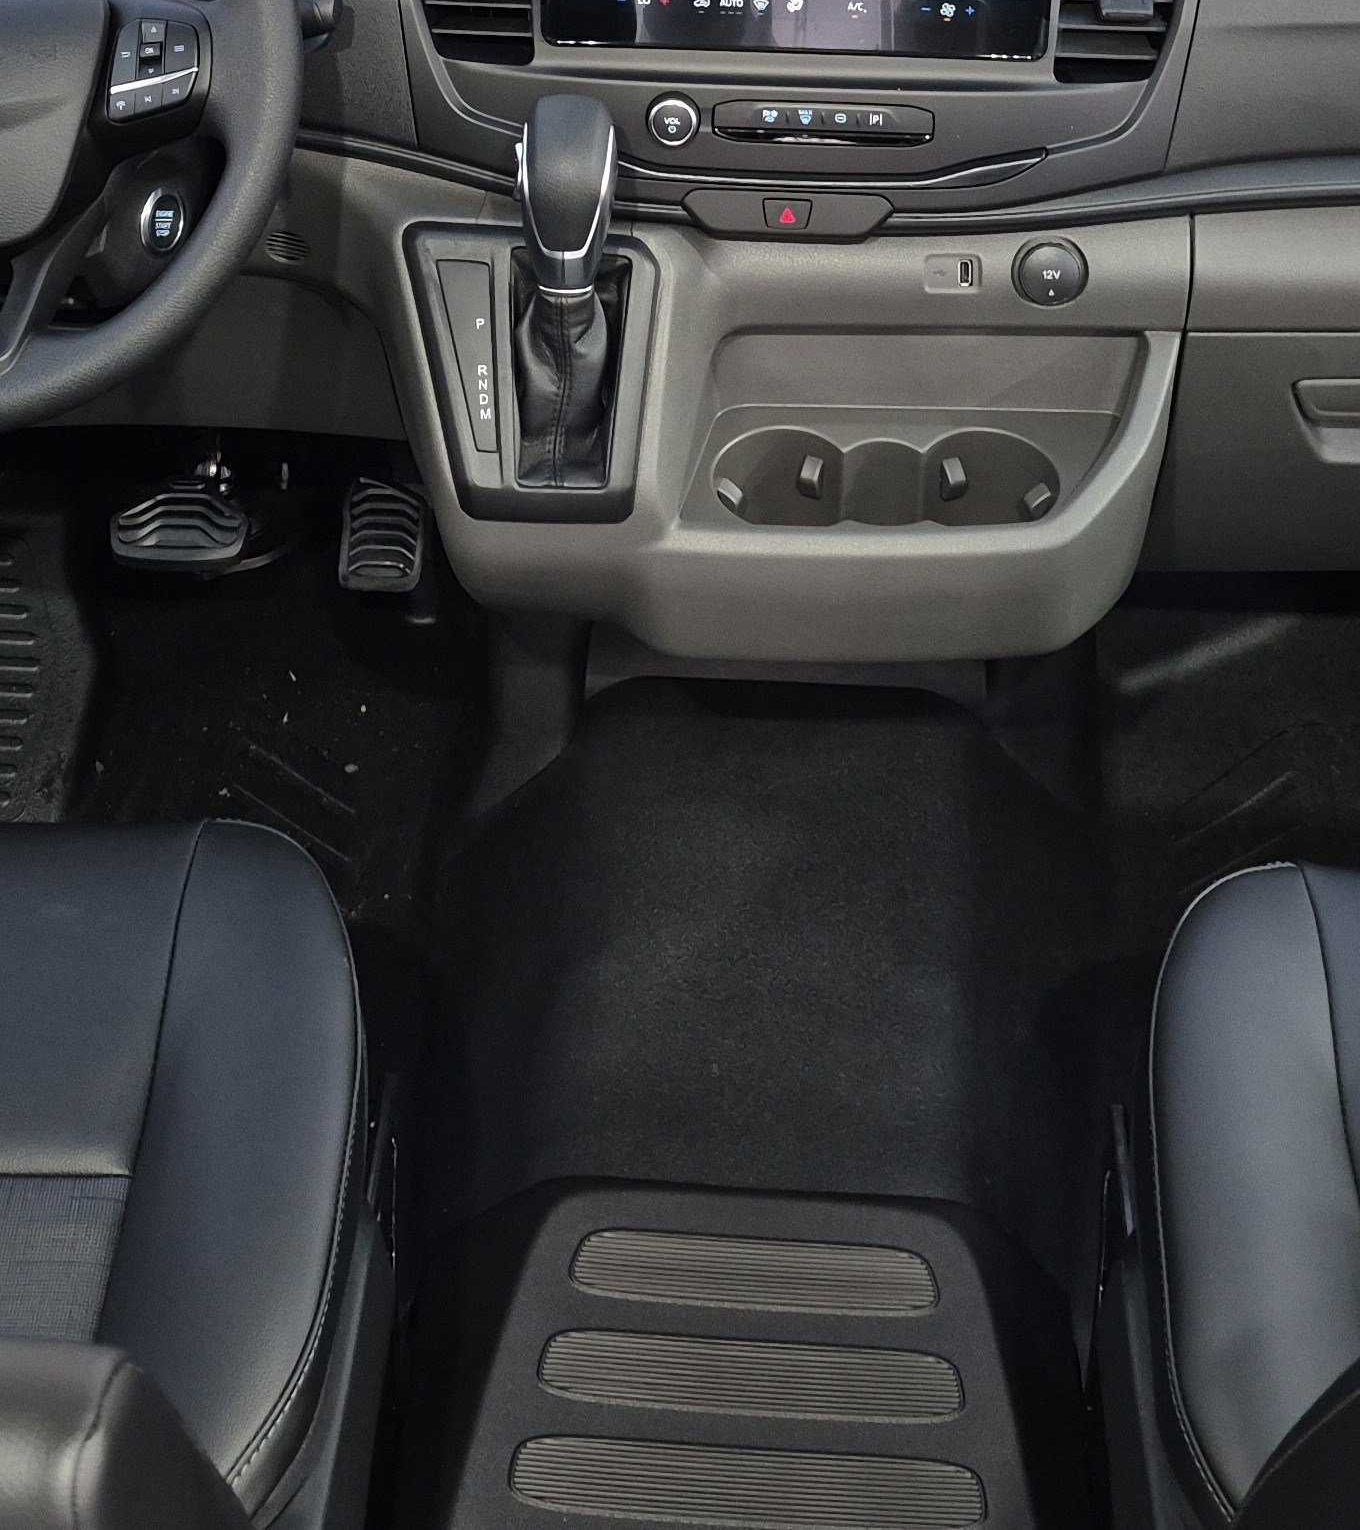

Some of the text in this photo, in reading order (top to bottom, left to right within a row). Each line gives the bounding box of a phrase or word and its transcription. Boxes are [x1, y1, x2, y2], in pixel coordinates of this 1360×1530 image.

[664, 116, 681, 126] VOL
[1042, 269, 1061, 281] 12V
[475, 318, 485, 330] P
[477, 364, 488, 377] R
[478, 378, 488, 391] N
[479, 393, 489, 405] D
[480, 407, 492, 420] M
